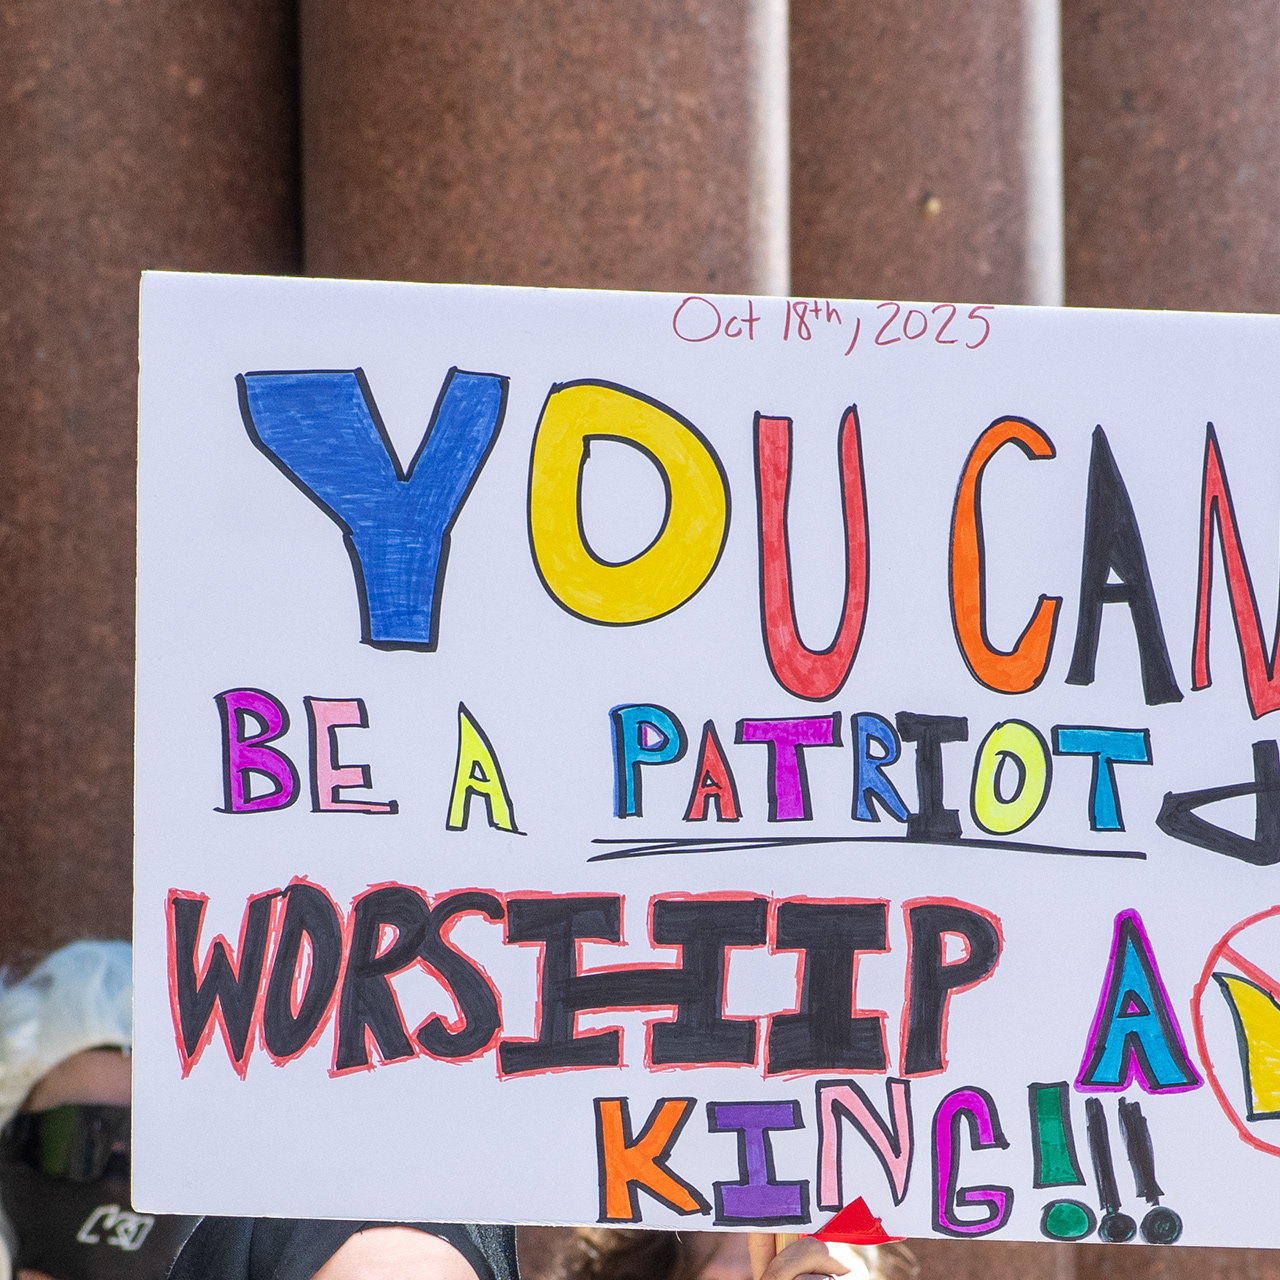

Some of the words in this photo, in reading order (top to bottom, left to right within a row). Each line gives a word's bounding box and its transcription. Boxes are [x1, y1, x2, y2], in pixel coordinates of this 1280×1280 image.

[672, 296, 761, 342] Oct
[874, 301, 996, 350] 2025
[237, 366, 869, 702] YOU
[213, 688, 398, 815] BE
[445, 701, 527, 836] A
[607, 702, 1151, 846] PATRIOT
[165, 875, 1004, 1081] WORSHIP
[1074, 907, 1204, 1096] A
[594, 1078, 1182, 1247] KING!!!
